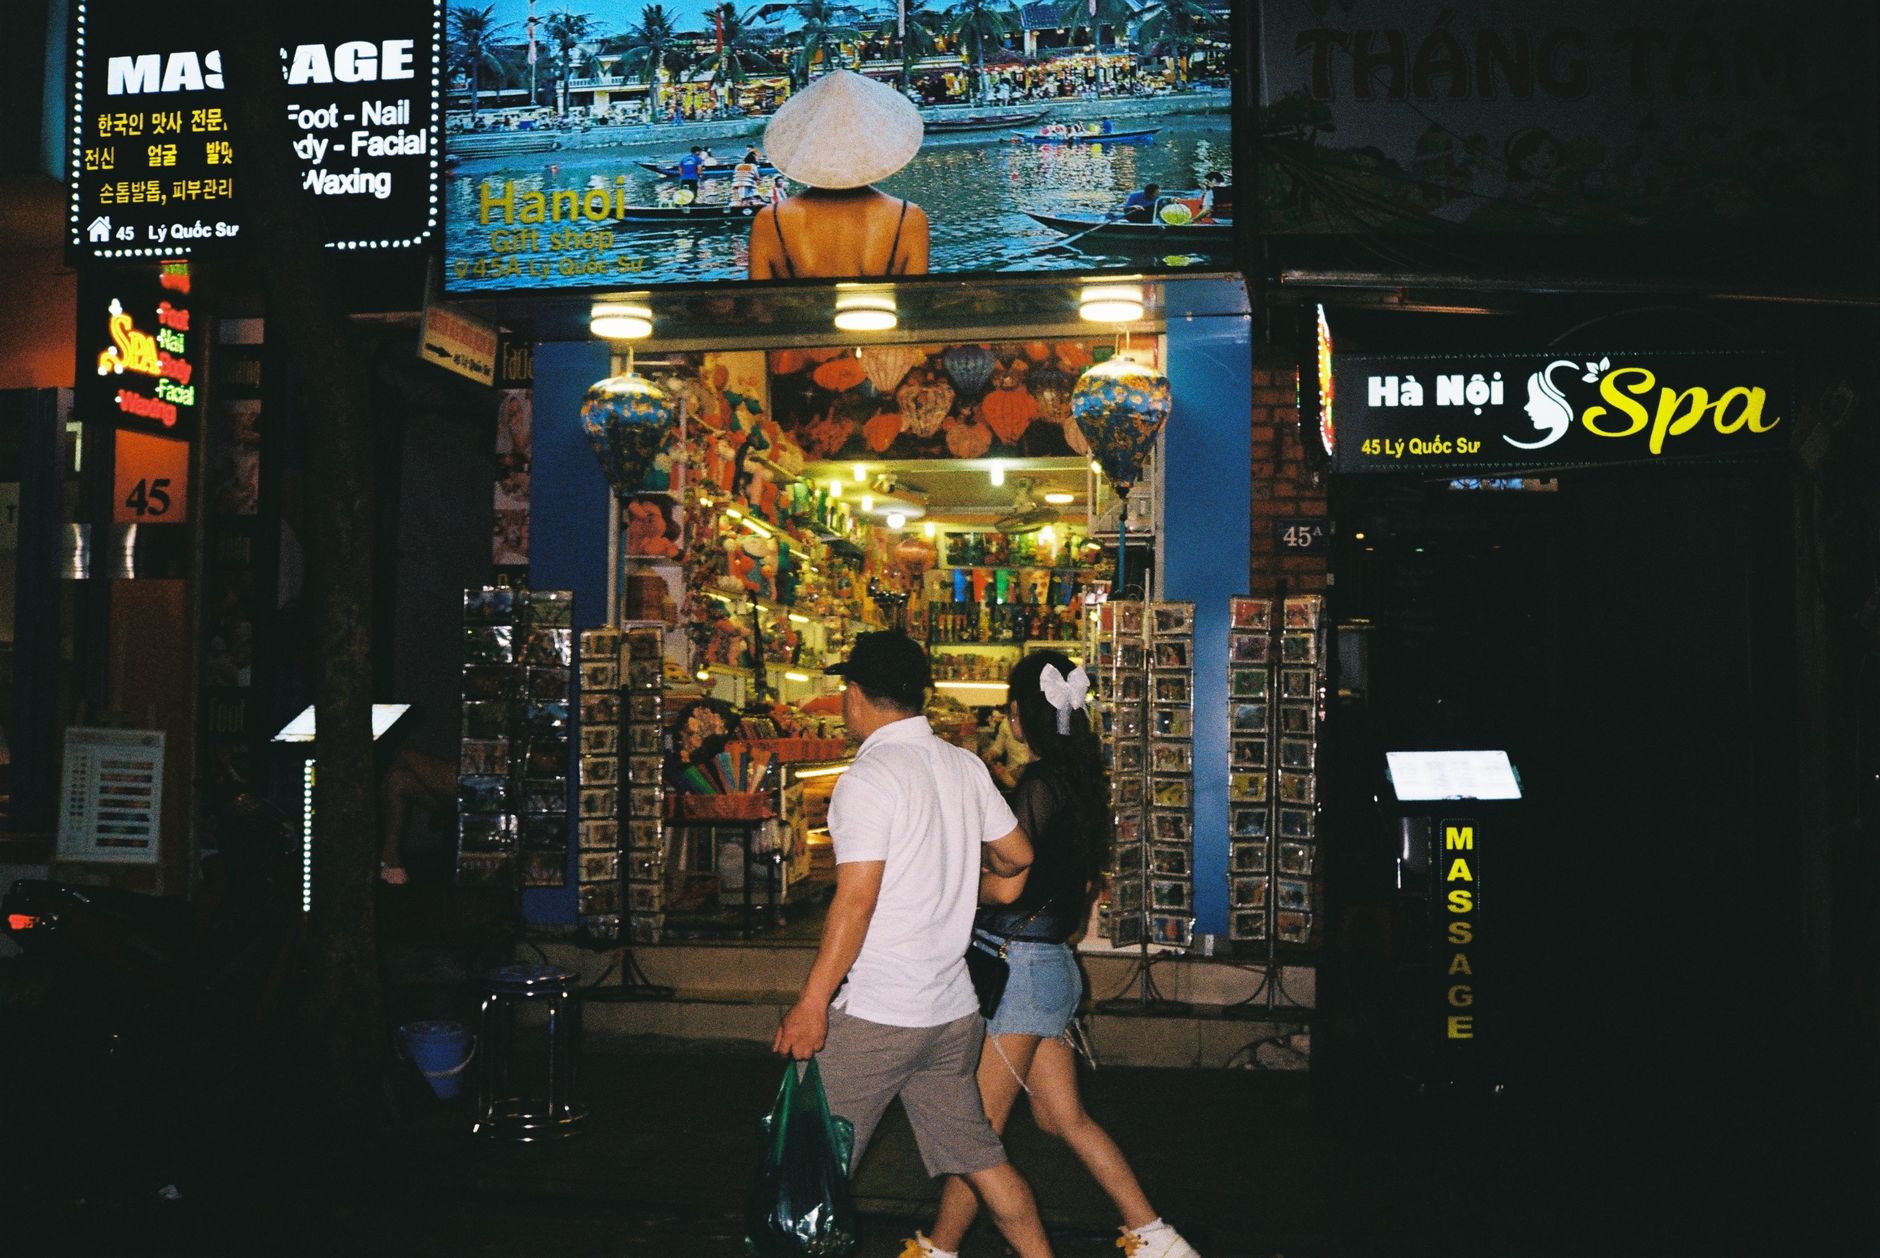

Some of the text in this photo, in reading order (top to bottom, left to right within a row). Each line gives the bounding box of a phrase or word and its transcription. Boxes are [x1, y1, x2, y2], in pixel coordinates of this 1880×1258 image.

[1295, 6, 1592, 100] THÁNG
[98, 107, 228, 138] 한국인 맛사 전문
[361, 99, 410, 127] Nail
[84, 146, 116, 171] 전신
[147, 143, 178, 167] 얼굴
[351, 128, 427, 158] Facial
[172, 177, 233, 201] 피부관리
[301, 167, 392, 199] Waxing
[479, 175, 626, 226] Hanoi
[116, 219, 239, 243] 45 Lý Quốc Sư
[490, 226, 615, 255] Gift shop
[472, 255, 522, 279] 45A
[159, 328, 185, 354] Nail
[158, 378, 195, 406] Facial
[117, 389, 177, 428] Waxing
[1367, 366, 1781, 456] Hà Nội Spa
[1361, 434, 1481, 459] 45 Lý Quốc Sư
[125, 477, 171, 517] 45
[1283, 526, 1323, 548] 45A
[1445, 826, 1474, 1039] MASSAGE
